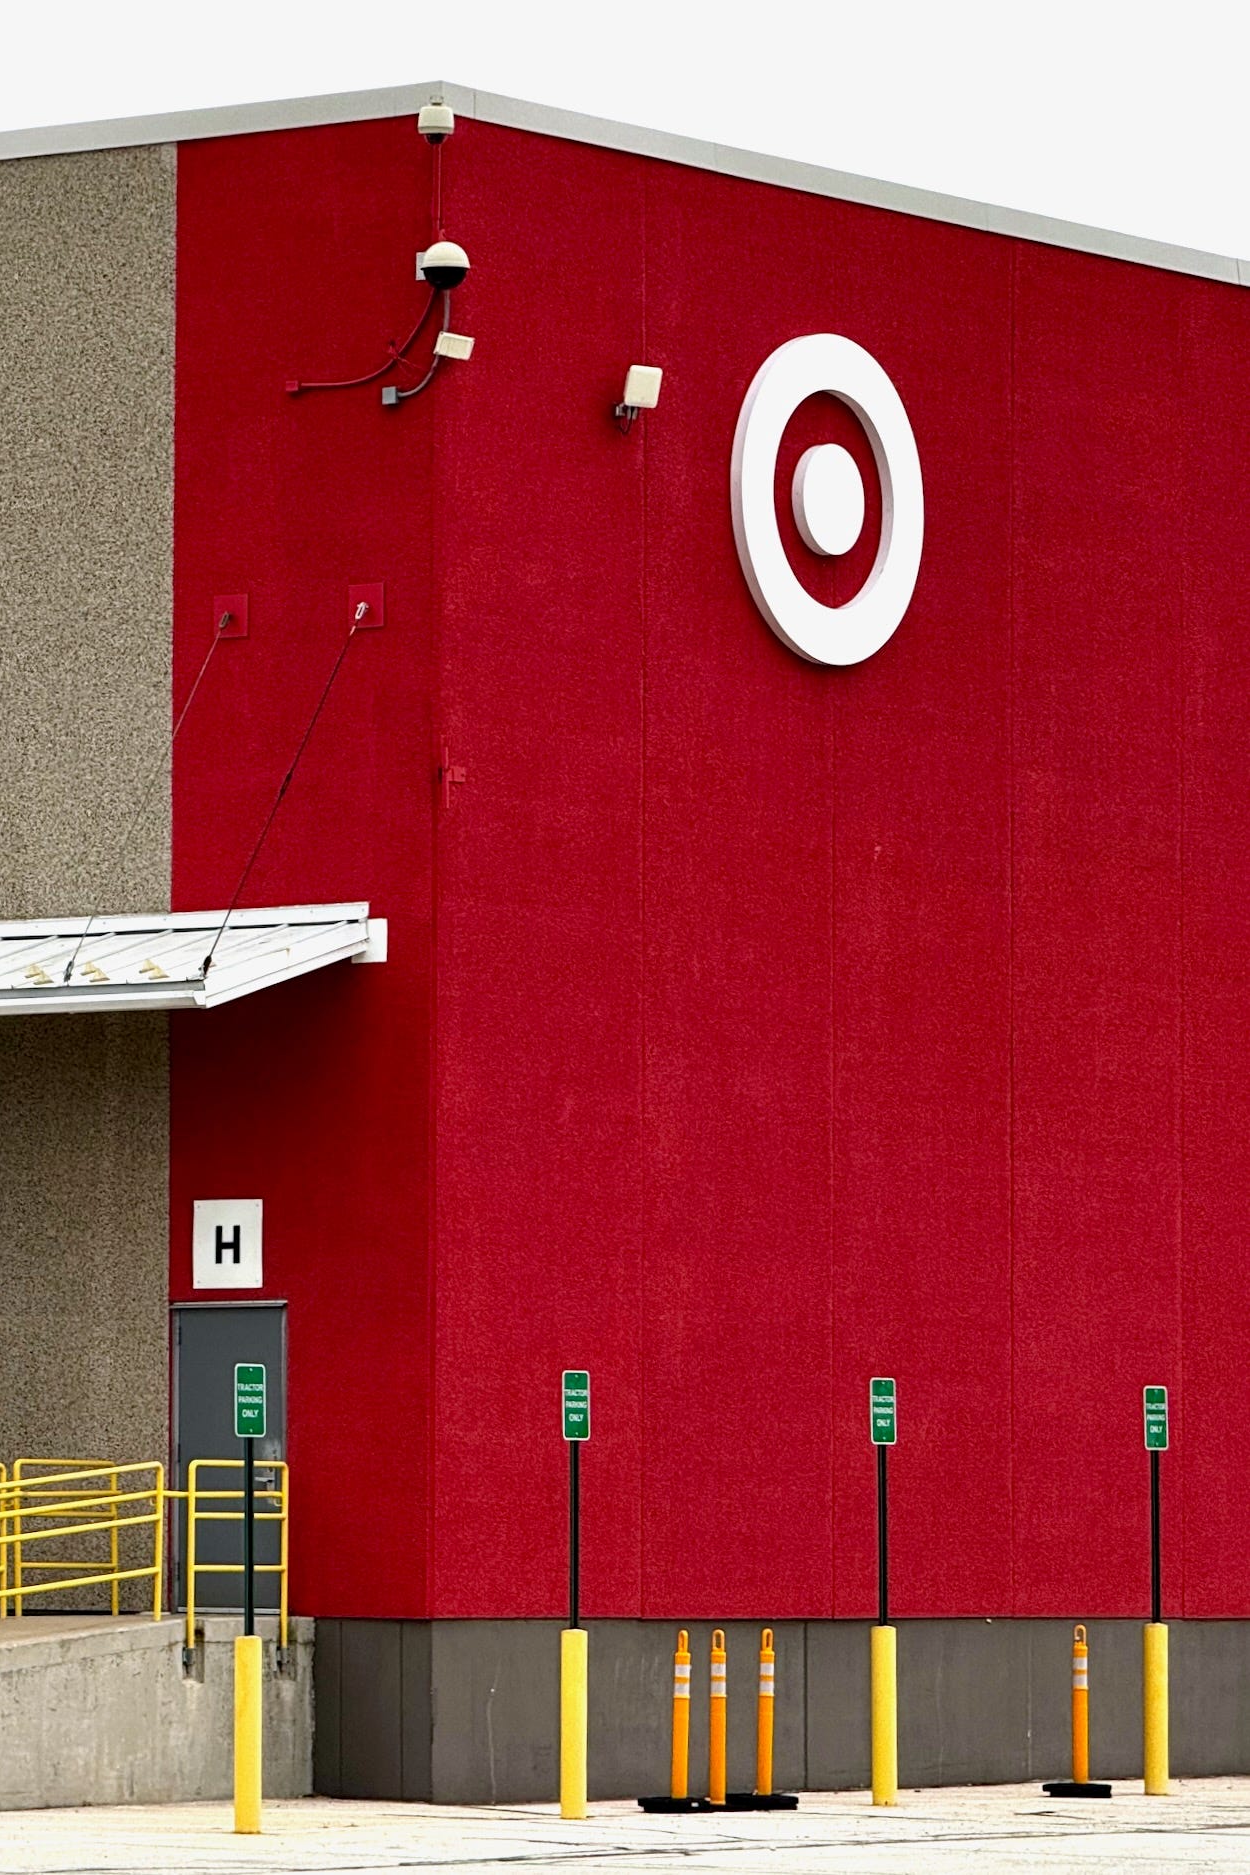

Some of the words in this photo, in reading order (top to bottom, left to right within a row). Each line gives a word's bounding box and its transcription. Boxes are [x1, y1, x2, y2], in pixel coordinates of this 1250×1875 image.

[215, 1225, 240, 1264] H
[237, 1383, 264, 1392] TRACTOR
[241, 1409, 259, 1418] ONLY
